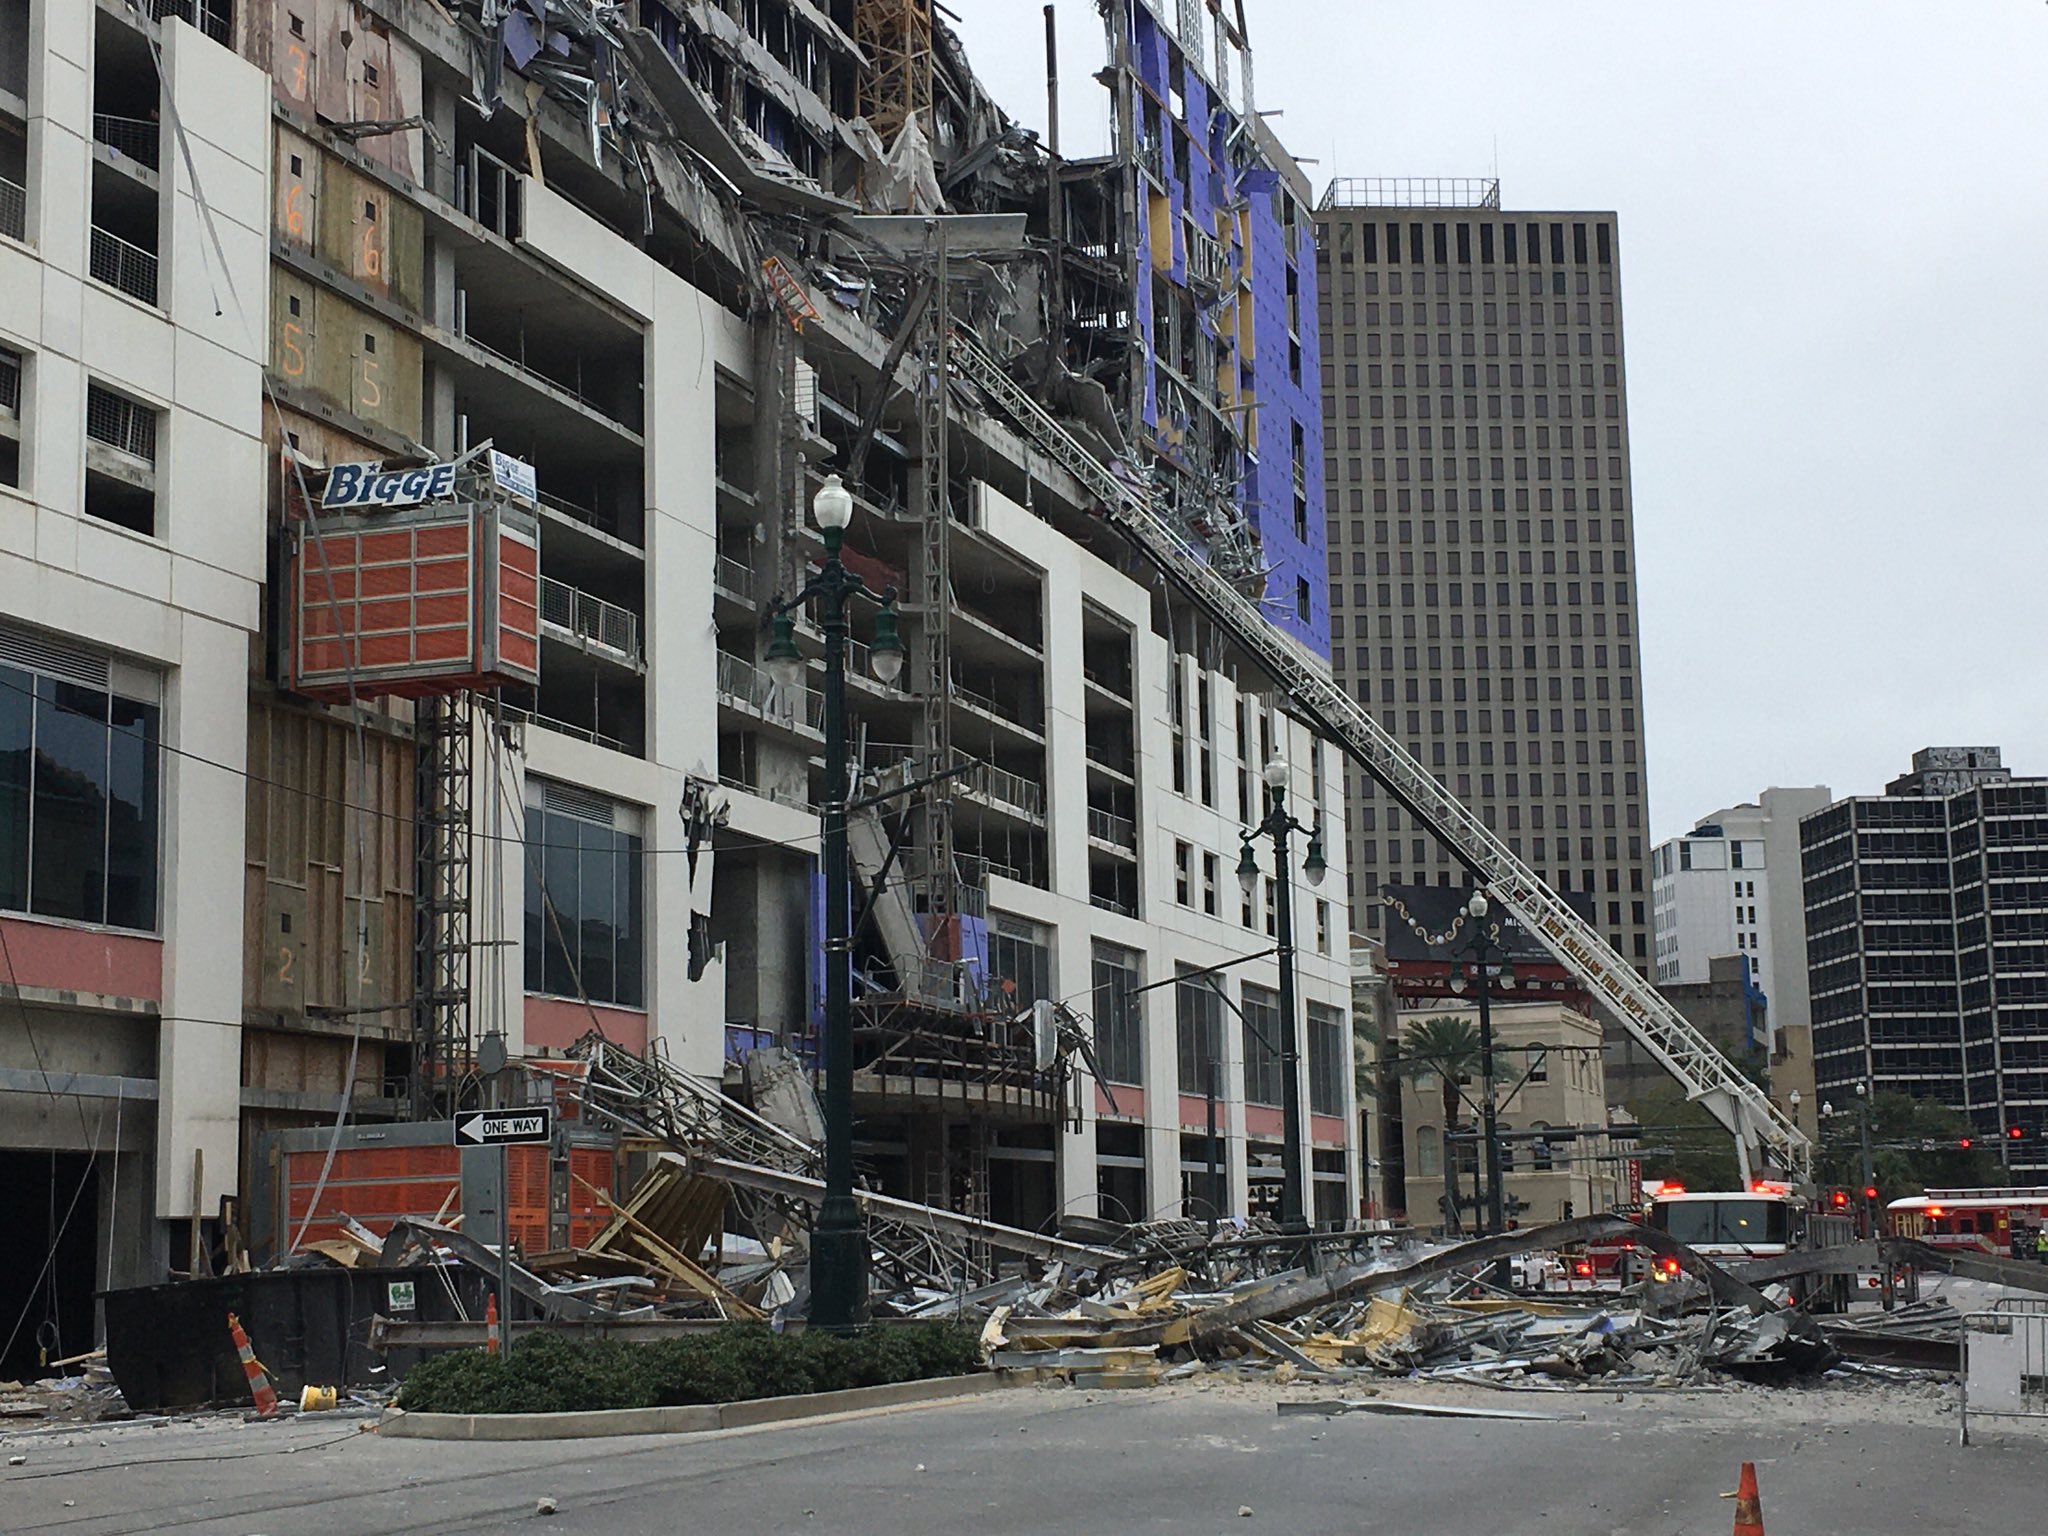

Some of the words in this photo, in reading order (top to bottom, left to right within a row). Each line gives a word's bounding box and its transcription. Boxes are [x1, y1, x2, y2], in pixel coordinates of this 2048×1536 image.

[287, 44, 306, 95] 7
[285, 185, 303, 234] 6
[363, 226, 379, 276] 6
[282, 322, 305, 375] 5
[361, 359, 381, 407] 5
[278, 947, 294, 984] 2
[357, 951, 373, 985] 2
[1543, 917, 1565, 939] NEW
[1563, 937, 1603, 977] ORLEANS
[1601, 973, 1625, 997] FIRE
[483, 1120, 508, 1134] ONE
[513, 1119, 540, 1133] WAY
